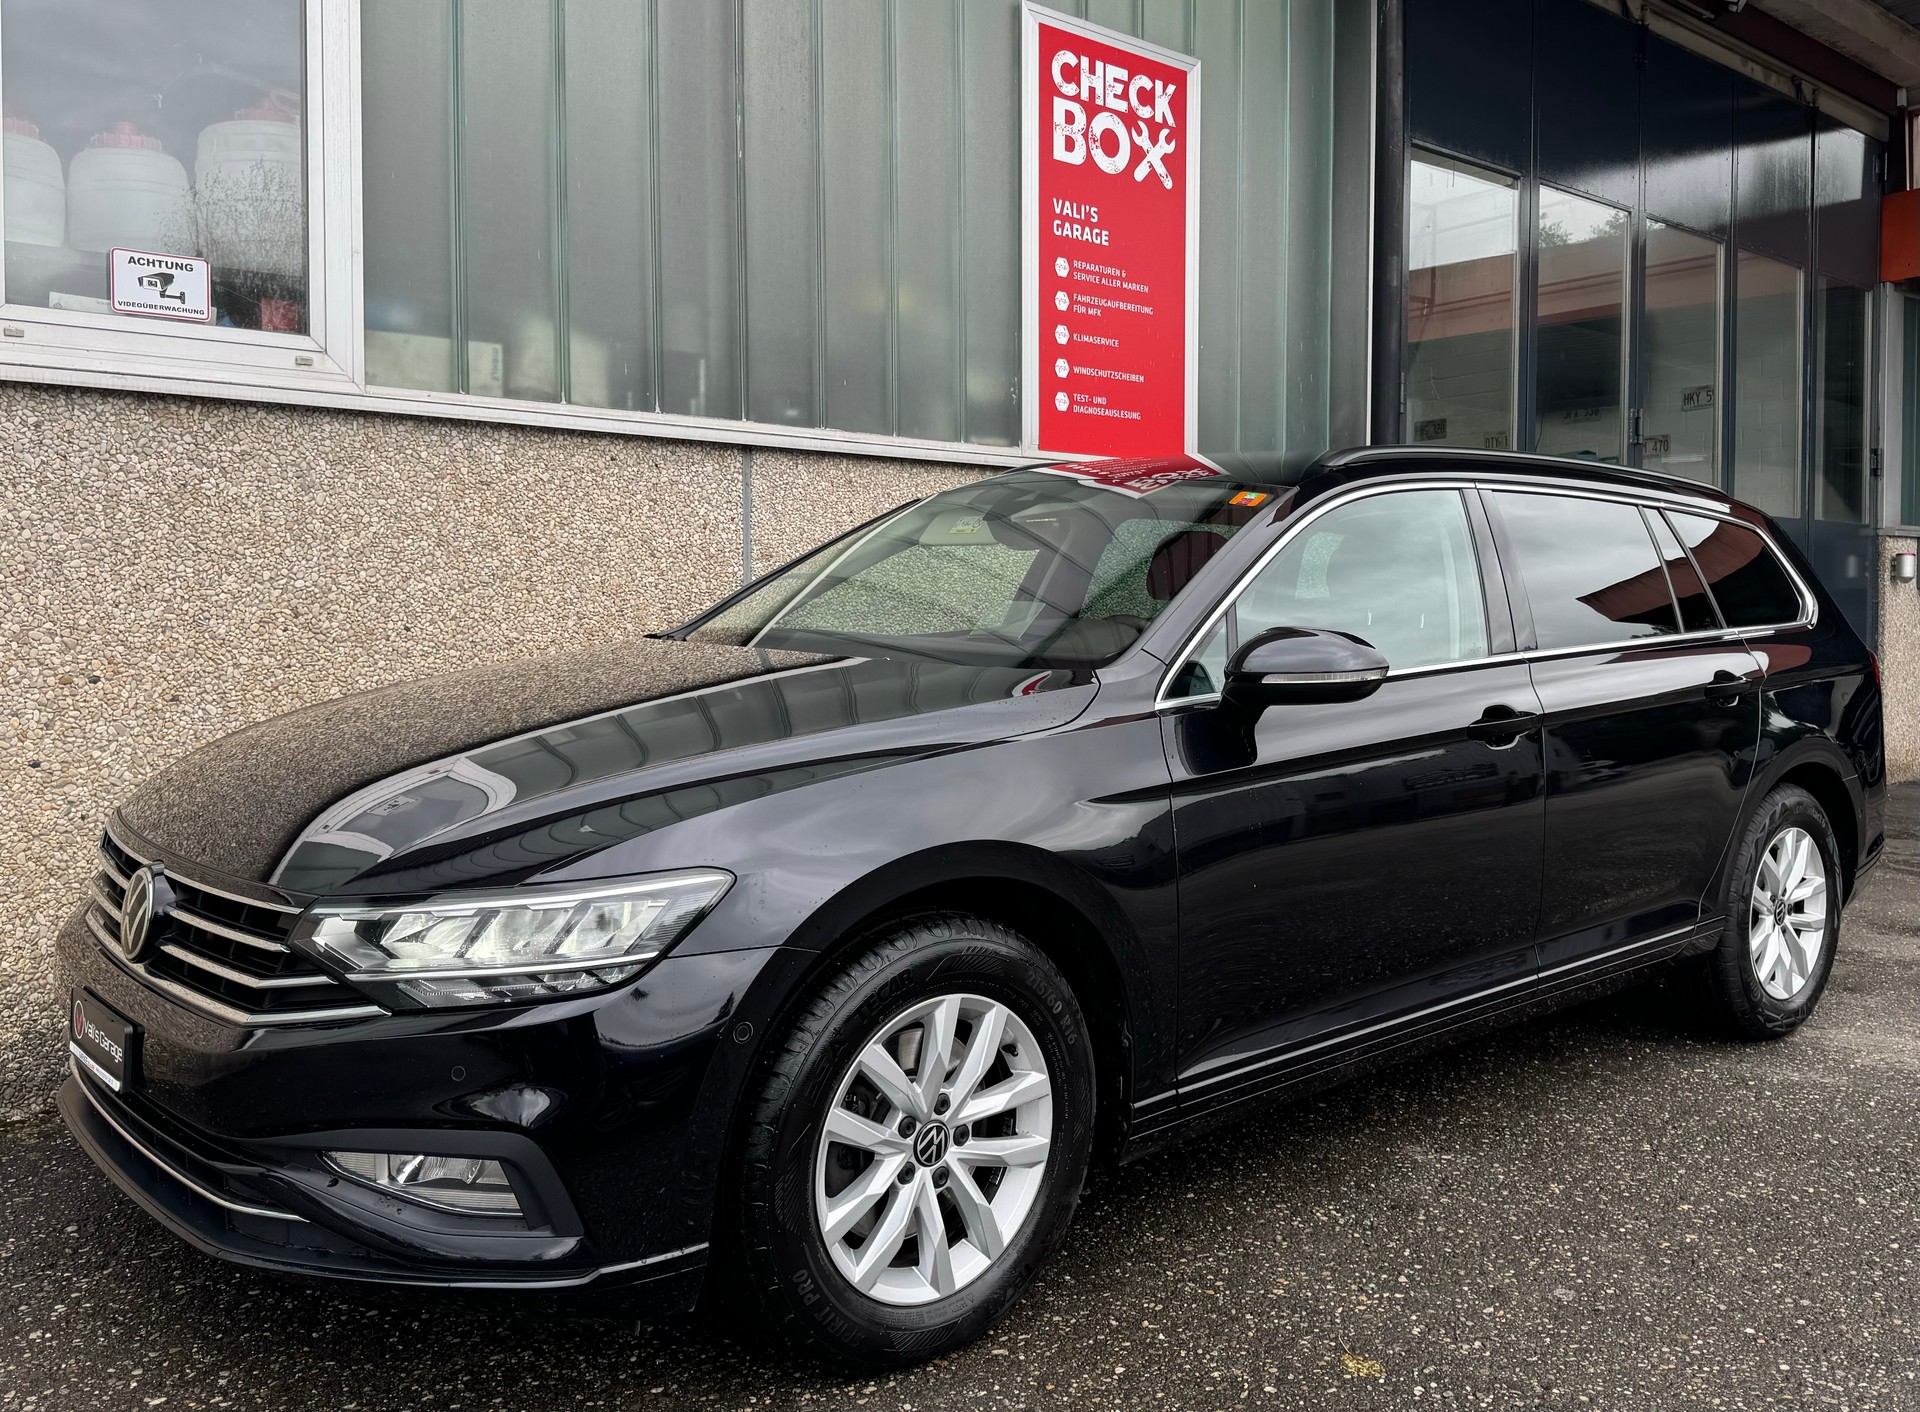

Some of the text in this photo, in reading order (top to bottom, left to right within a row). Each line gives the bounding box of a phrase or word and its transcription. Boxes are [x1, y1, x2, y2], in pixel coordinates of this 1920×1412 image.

[1051, 50, 1177, 127] CHECK
[1052, 96, 1176, 189] BOX
[1053, 197, 1098, 223] VALI'S
[1053, 220, 1109, 246] GARAGE
[127, 256, 194, 272] ACHTUNG
[1073, 260, 1127, 278] REPARATUREN &
[1073, 272, 1149, 293] SERVICE ALLER MARKEN
[117, 300, 205, 315] VIDEOÜBERWACHUNG
[1073, 294, 1154, 315] FAHRZEUGAUFBEREITUNG
[1073, 304, 1102, 317] FÜR MFK
[1073, 333, 1119, 347] KLIMASERVICE
[1073, 365, 1144, 383] WINDSCHUTZSCHEIBEN
[1073, 393, 1107, 405] TEST- UND
[1073, 404, 1141, 420] DIAGNOSEAUSLESUNG
